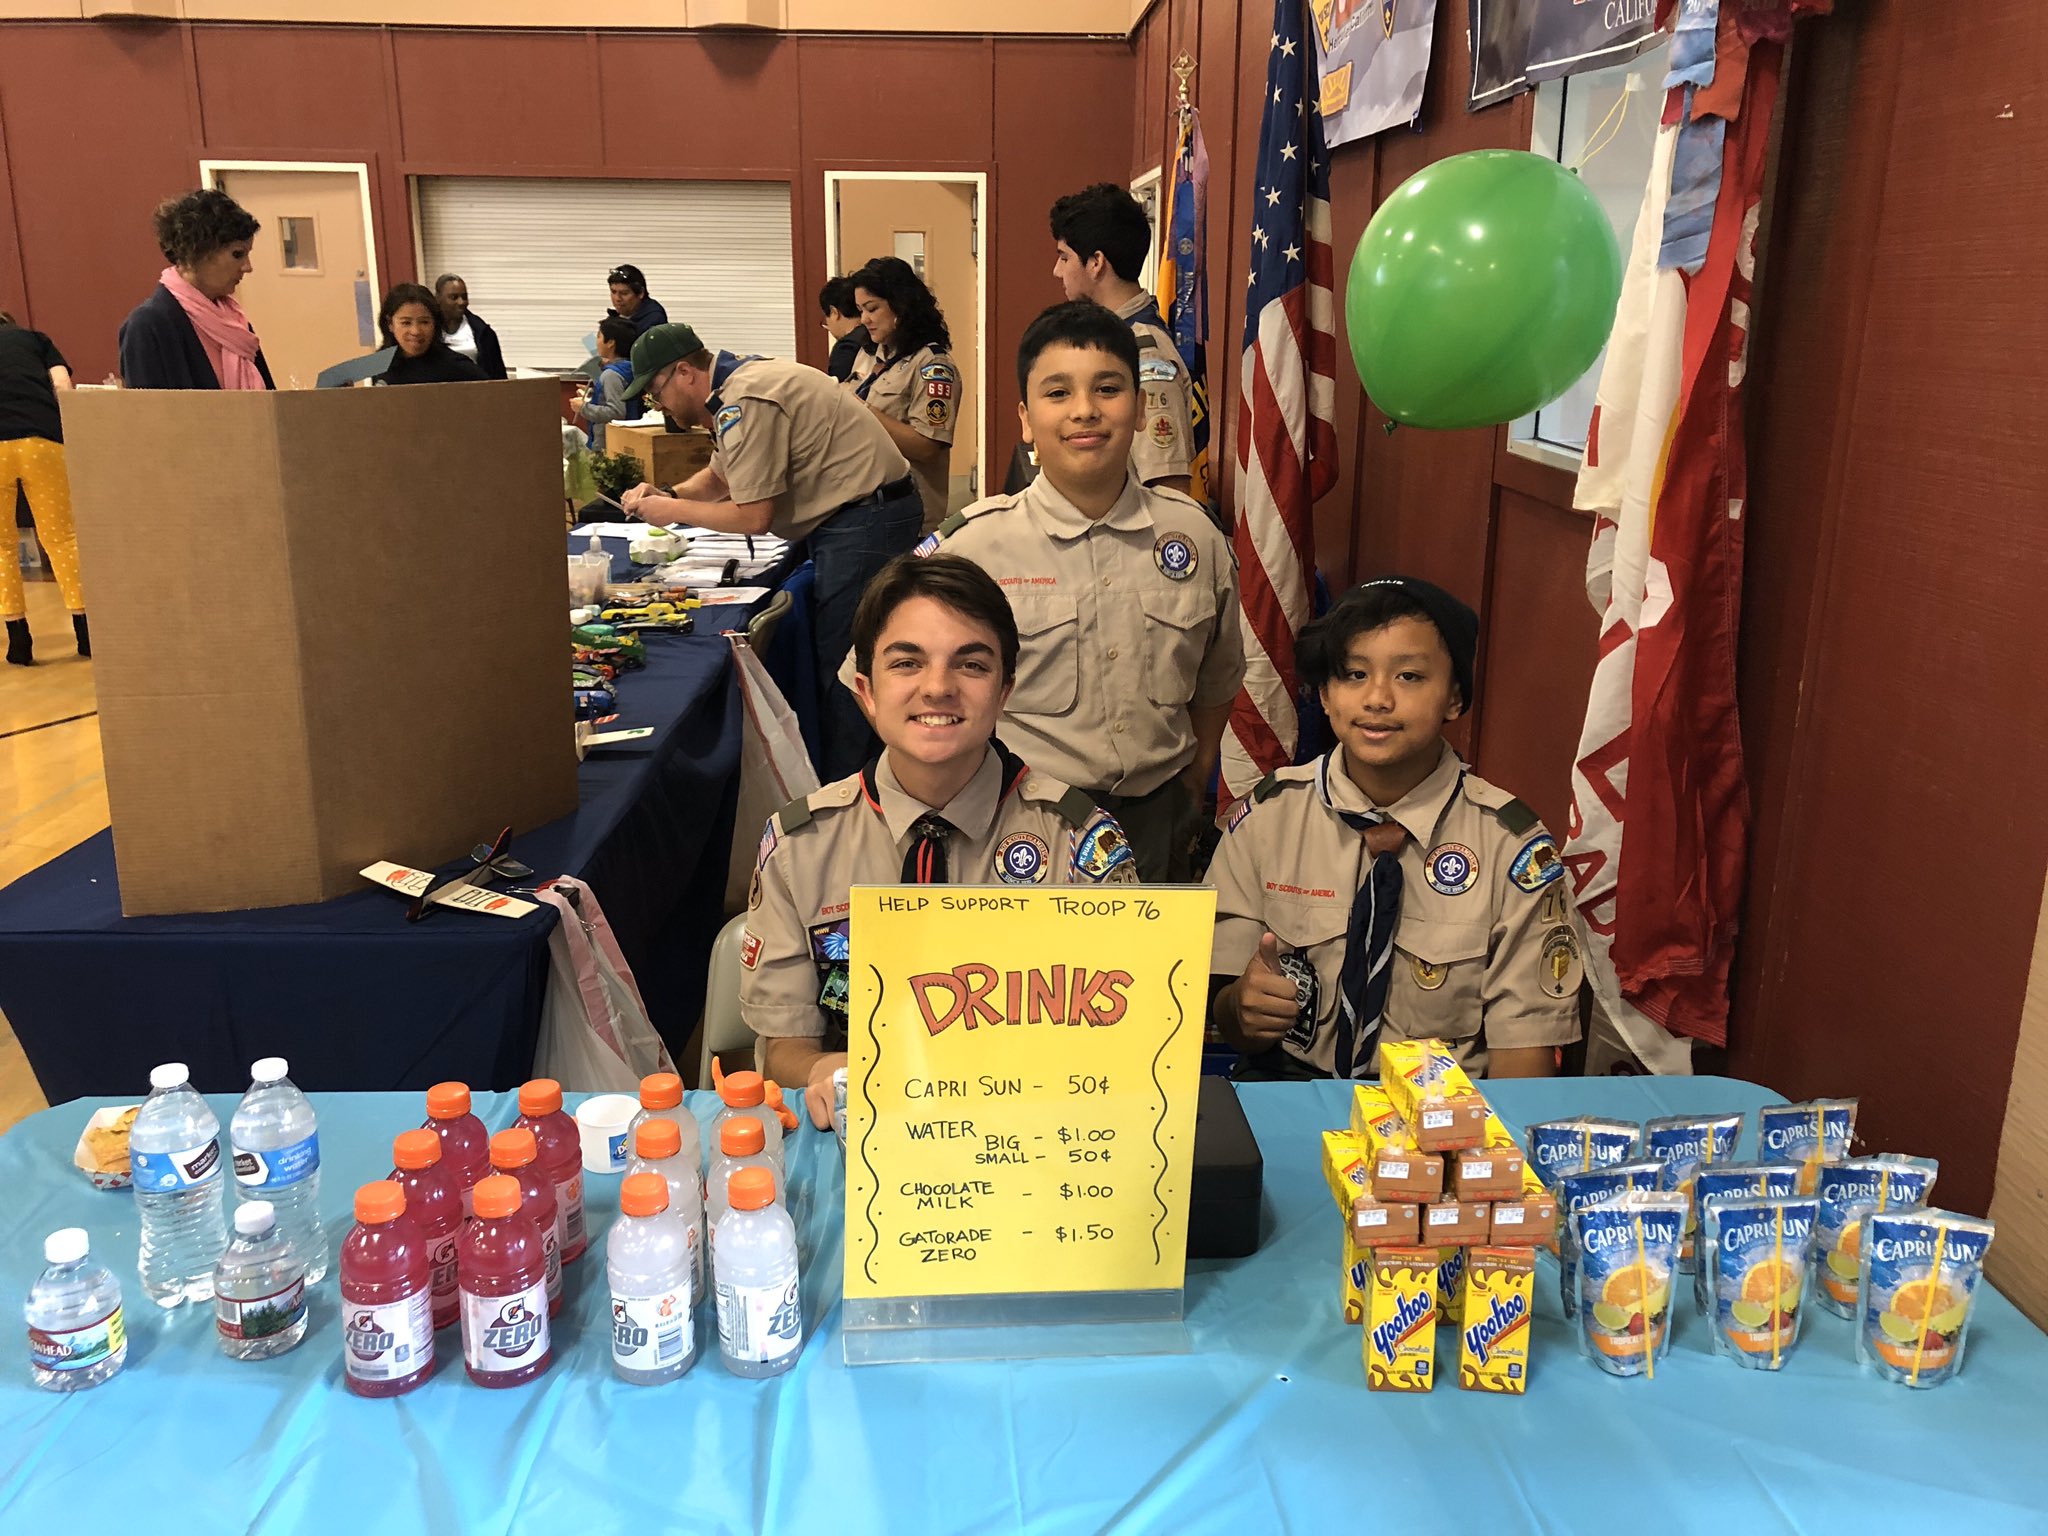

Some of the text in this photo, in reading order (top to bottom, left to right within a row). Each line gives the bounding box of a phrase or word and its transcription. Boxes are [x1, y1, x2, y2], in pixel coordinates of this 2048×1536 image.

[929, 383, 951, 397] 693
[1148, 392, 1168, 406] 76
[1266, 882, 1278, 890] BOY
[1279, 884, 1302, 895] SCOUTS
[1311, 889, 1335, 898] AMERICA
[879, 896, 1160, 920] HELP SUPPORT TROOP 76
[907, 962, 1135, 1037] DRINKS
[905, 1079, 967, 1098] CAPRI
[978, 1075, 1022, 1096] SUN
[1068, 1075, 1110, 1095] 50¢
[905, 1120, 977, 1139] WATER
[985, 1134, 1020, 1151] BIG
[1057, 1126, 1115, 1144] $1.00
[975, 1152, 1029, 1164] SMALL
[1068, 1149, 1111, 1163] 50¢
[900, 1181, 995, 1195] CHOCOLATE
[1060, 1182, 1113, 1200] $1.00
[917, 1196, 974, 1210] MILK
[899, 1229, 992, 1246] GATORADE
[1055, 1224, 1114, 1243] $1.50
[920, 1248, 977, 1263] ZERO
[483, 1314, 542, 1349] ZERO
